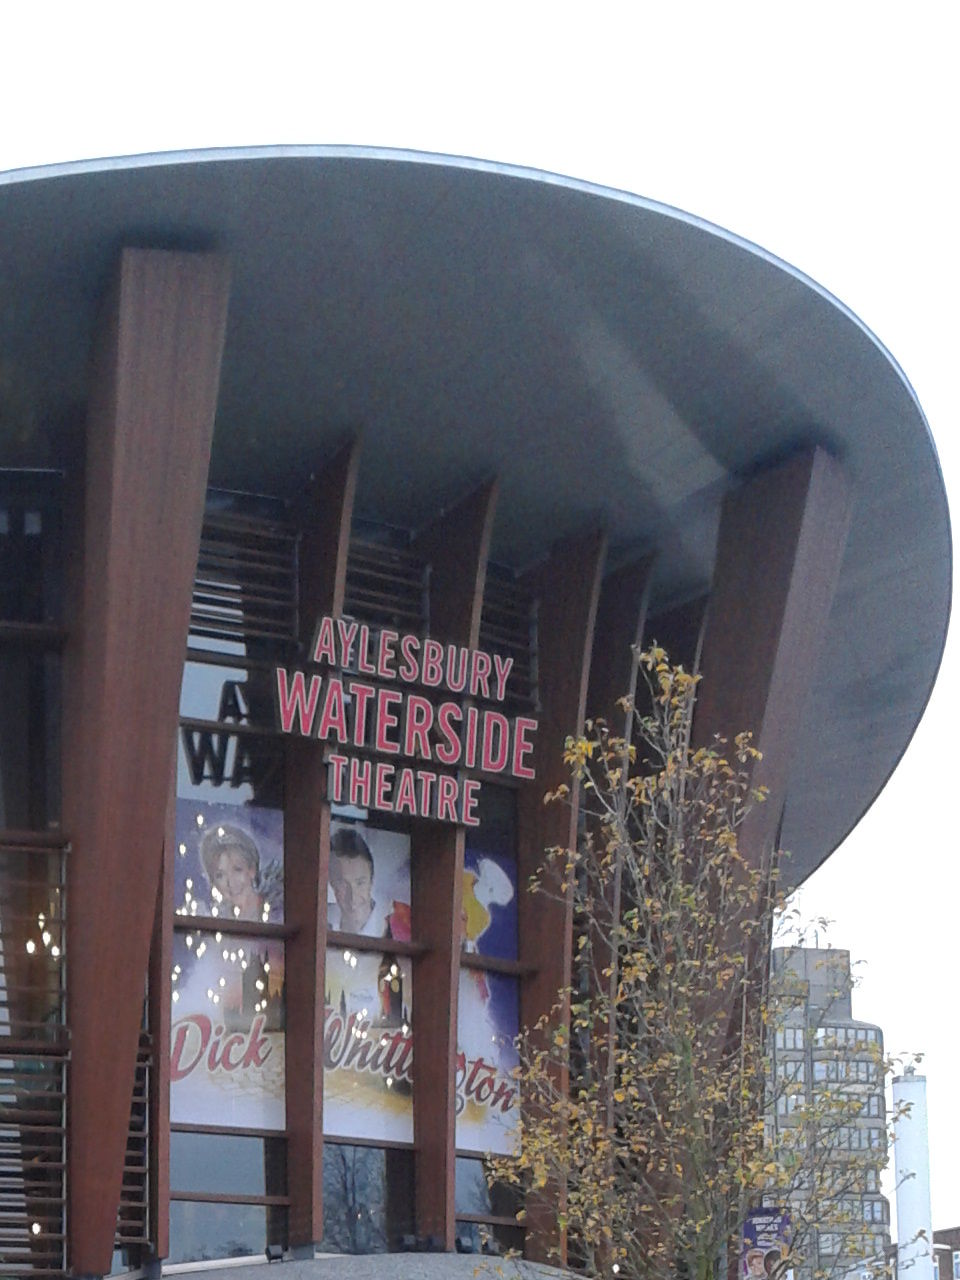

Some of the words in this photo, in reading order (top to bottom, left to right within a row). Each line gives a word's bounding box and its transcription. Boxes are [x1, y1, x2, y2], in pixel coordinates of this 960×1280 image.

[313, 616, 514, 701] AYLESBURY
[276, 667, 538, 780] WATERSIDE
[327, 754, 481, 826] THEATRE
[170, 1013, 273, 1082] Dick
